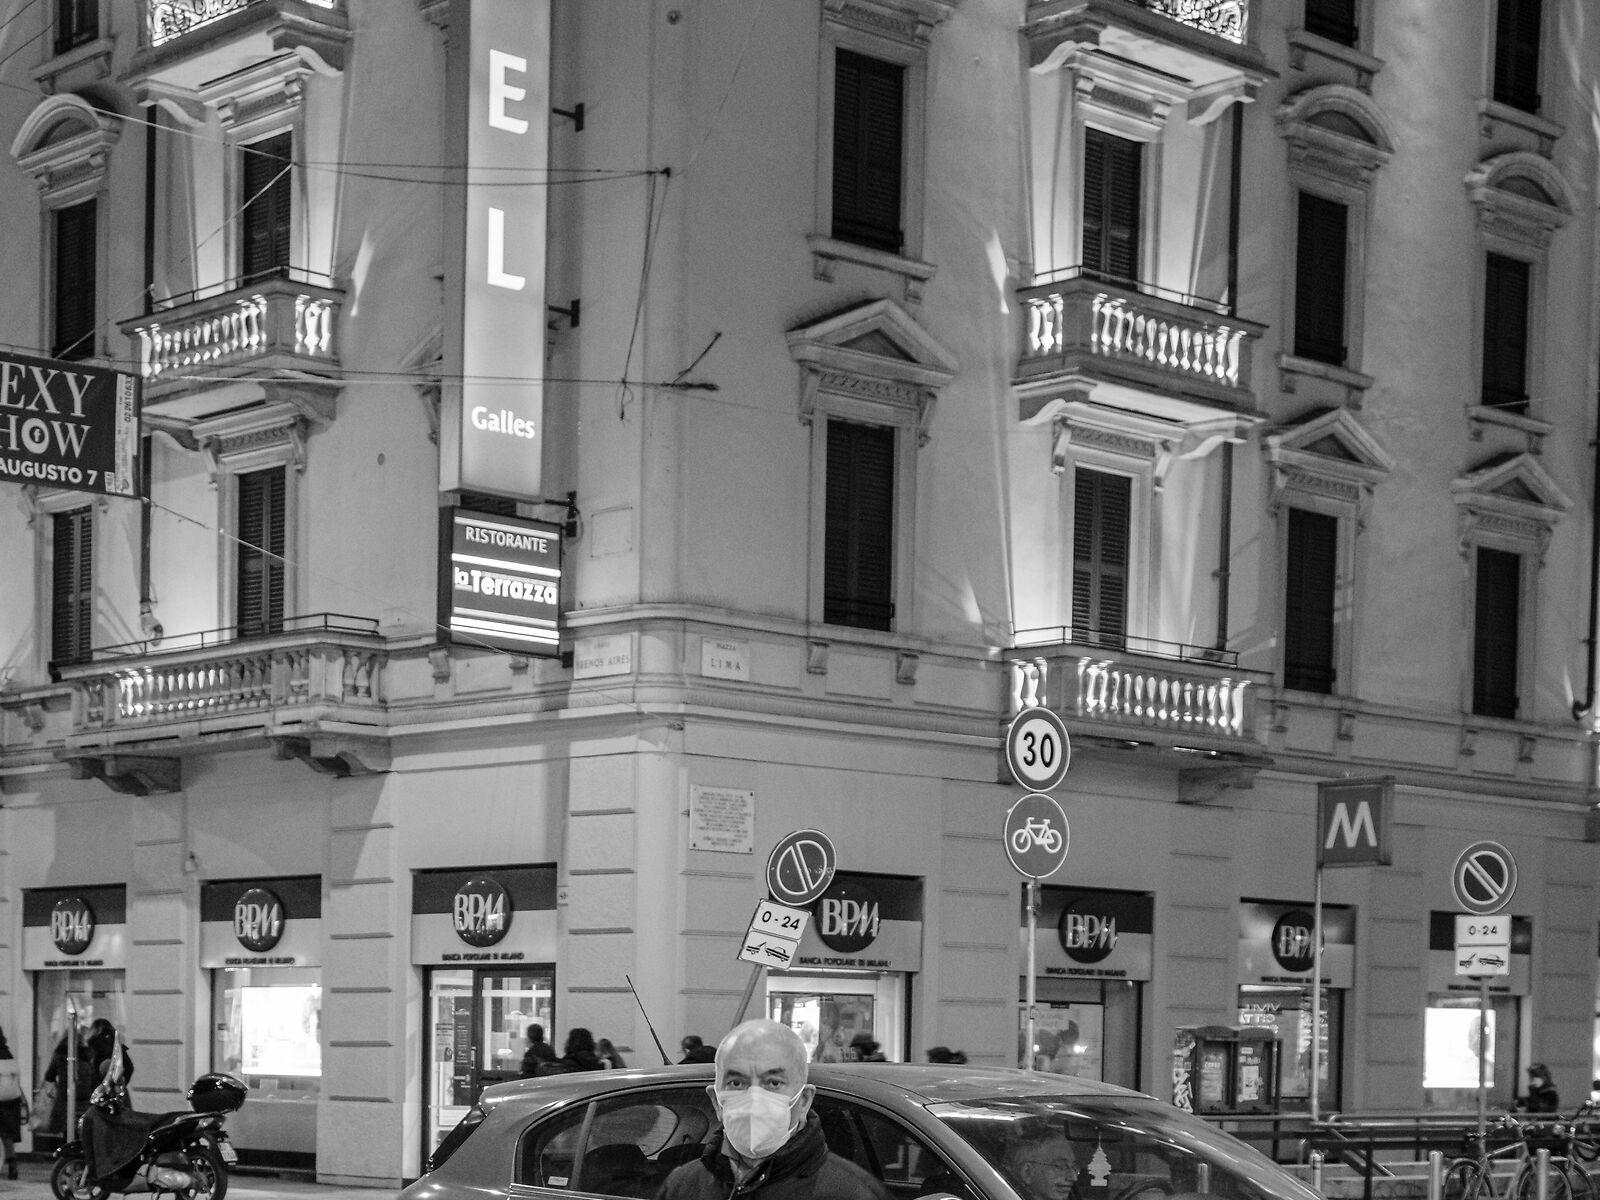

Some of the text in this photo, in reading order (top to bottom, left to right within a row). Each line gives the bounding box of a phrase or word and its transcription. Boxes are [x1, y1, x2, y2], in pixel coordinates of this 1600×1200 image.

[471, 406, 536, 440] Galles
[0, 457, 82, 484] AUGUSTO
[87, 469, 98, 486] 7
[465, 526, 548, 554] RISTORANTE
[454, 566, 558, 605] la Terrazza
[711, 658, 742, 671] LIMA
[1023, 731, 1054, 768] 30
[1325, 801, 1378, 849] M
[52, 910, 89, 942] BPM
[234, 903, 280, 940] BPM
[454, 893, 504, 931] BPM
[781, 916, 800, 930] 24
[822, 898, 880, 937] BPM
[1065, 913, 1118, 949] BPM
